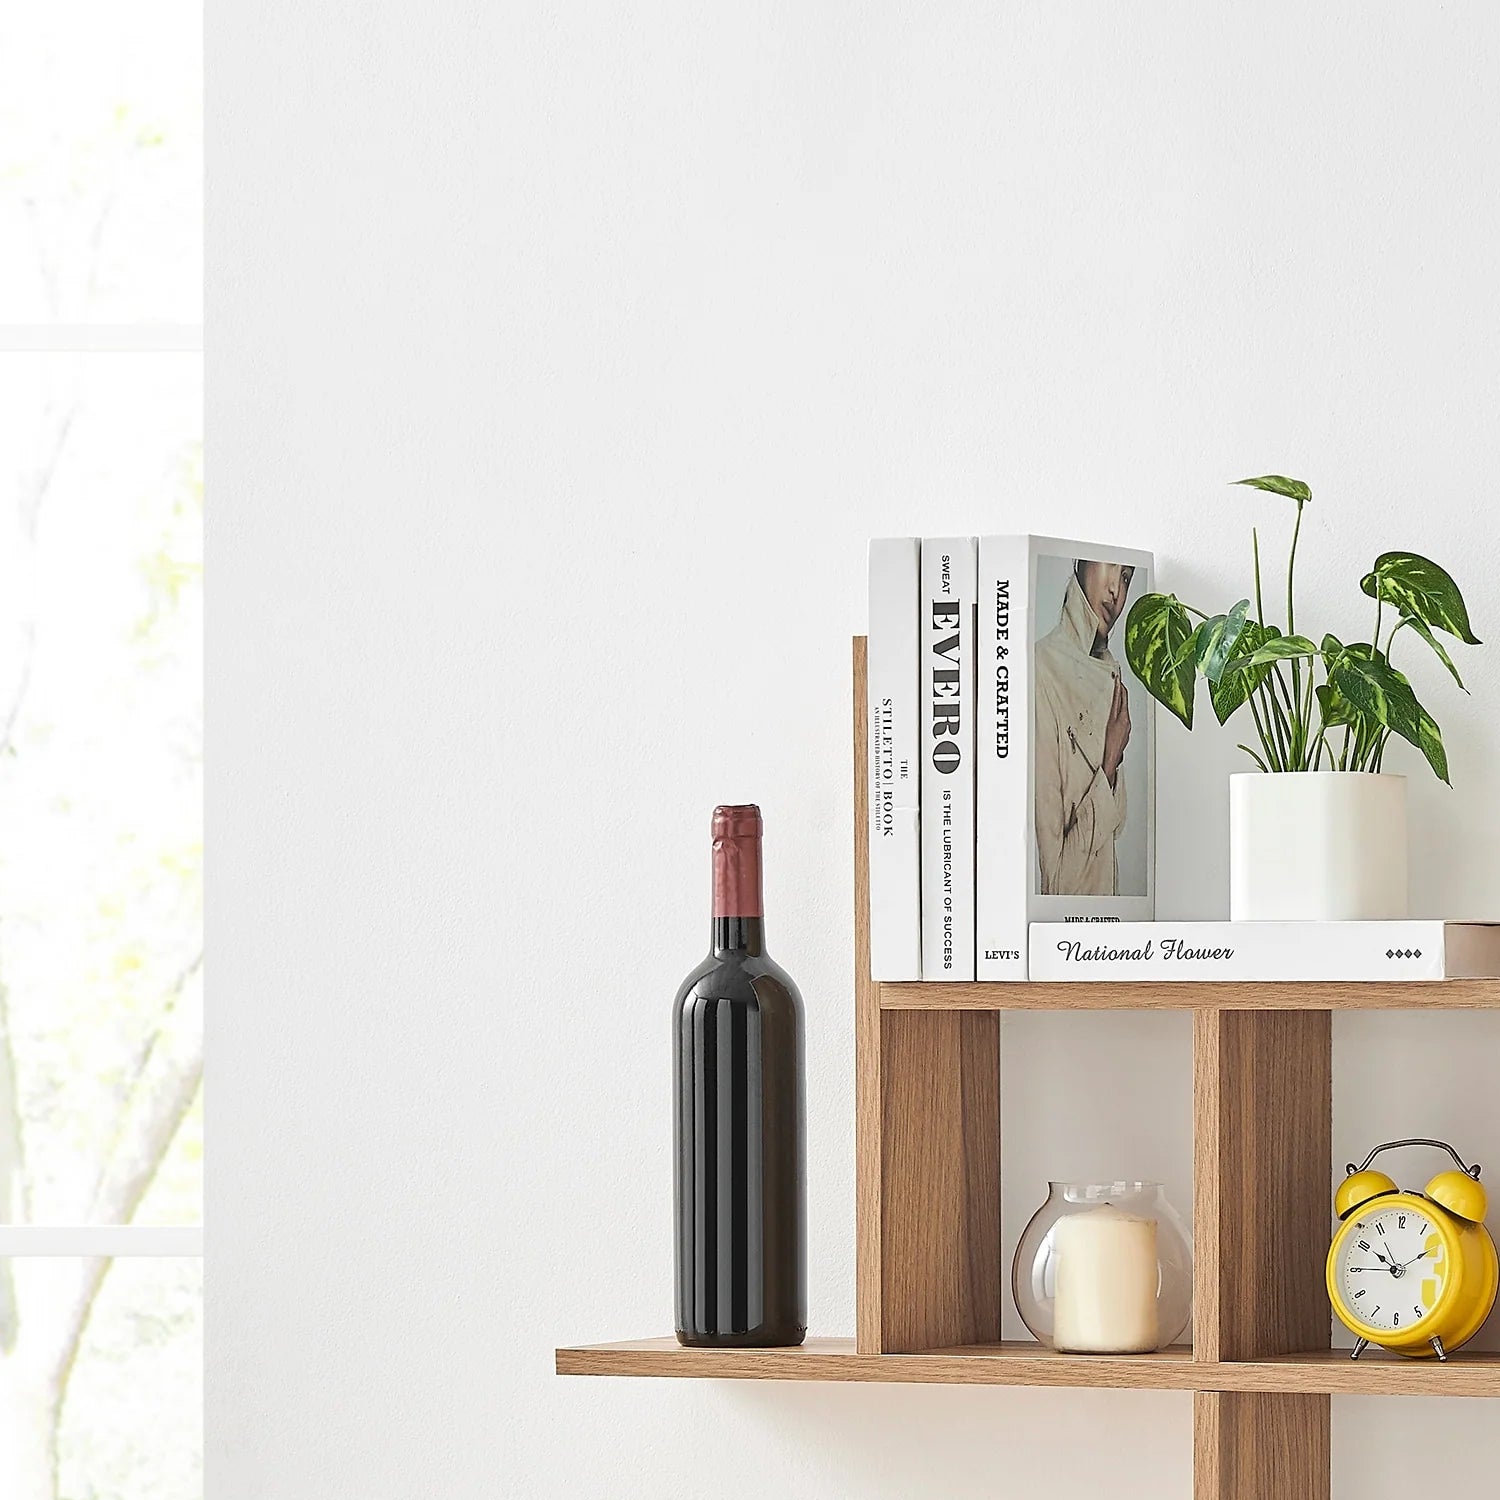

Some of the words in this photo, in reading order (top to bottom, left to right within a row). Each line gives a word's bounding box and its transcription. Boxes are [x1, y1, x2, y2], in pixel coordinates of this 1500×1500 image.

[941, 555, 951, 595] SWEAT
[996, 579, 1010, 640] MADE
[996, 645, 1009, 660] &
[932, 598, 961, 775] EVERO
[996, 665, 1009, 759] CRAFTED
[882, 698, 893, 780] STILETTO
[900, 759, 908, 779] THE
[942, 790, 951, 801] IS
[883, 791, 894, 837] BOOK
[942, 803, 952, 826] THE
[943, 829, 952, 894] LUBRICANT
[943, 897, 952, 912] OF
[943, 915, 953, 970] SUCCESS
[985, 950, 1020, 960] LEVI'S
[1057, 939, 1154, 962] National
[1160, 939, 1235, 960] Flower
[1375, 1222, 1385, 1236] 11
[1398, 1215, 1406, 1229] 12
[1420, 1223, 1427, 1236] 1
[1358, 1240, 1370, 1252] 10
[1354, 1289, 1366, 1299] 8
[1371, 1305, 1380, 1318] 7
[1393, 1312, 1399, 1326] 6
[1414, 1305, 1423, 1318] 5
